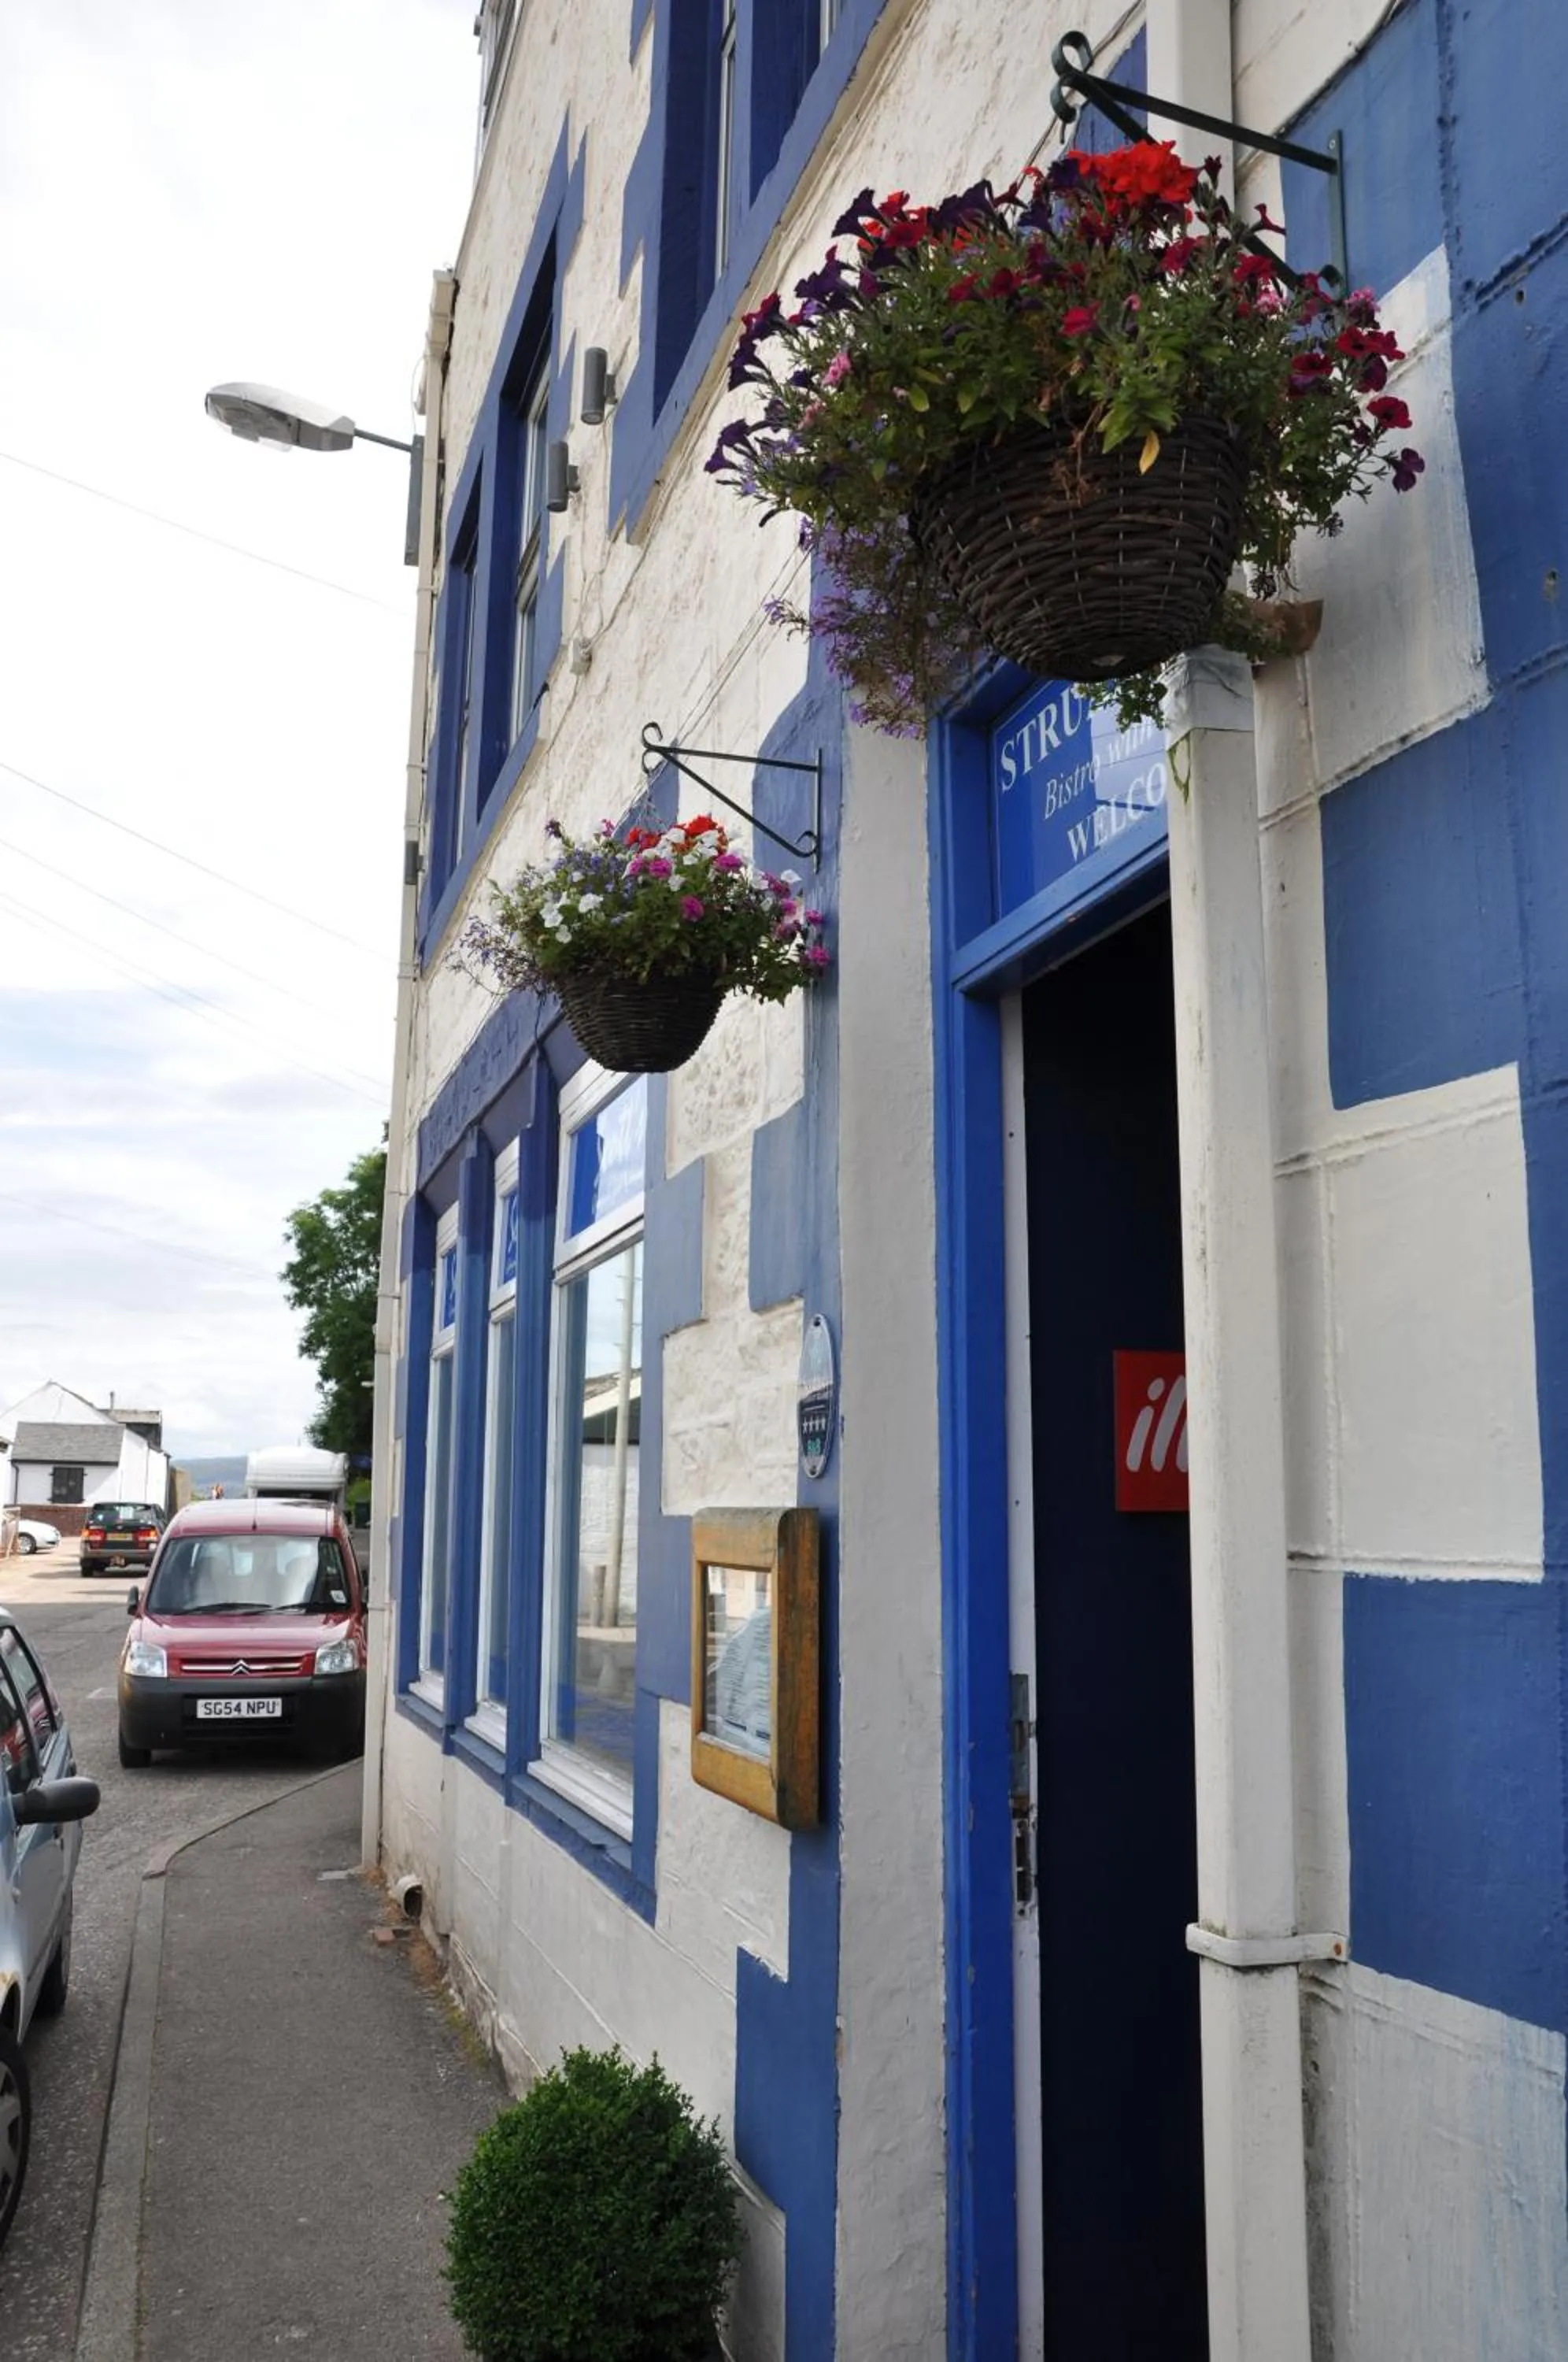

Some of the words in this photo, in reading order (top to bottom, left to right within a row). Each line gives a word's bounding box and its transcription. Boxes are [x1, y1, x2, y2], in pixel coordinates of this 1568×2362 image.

[1000, 684, 1093, 794] STRU
[1044, 753, 1101, 820] Bistro
[204, 1701, 242, 1716] SG54
[246, 1701, 276, 1714] NPU
